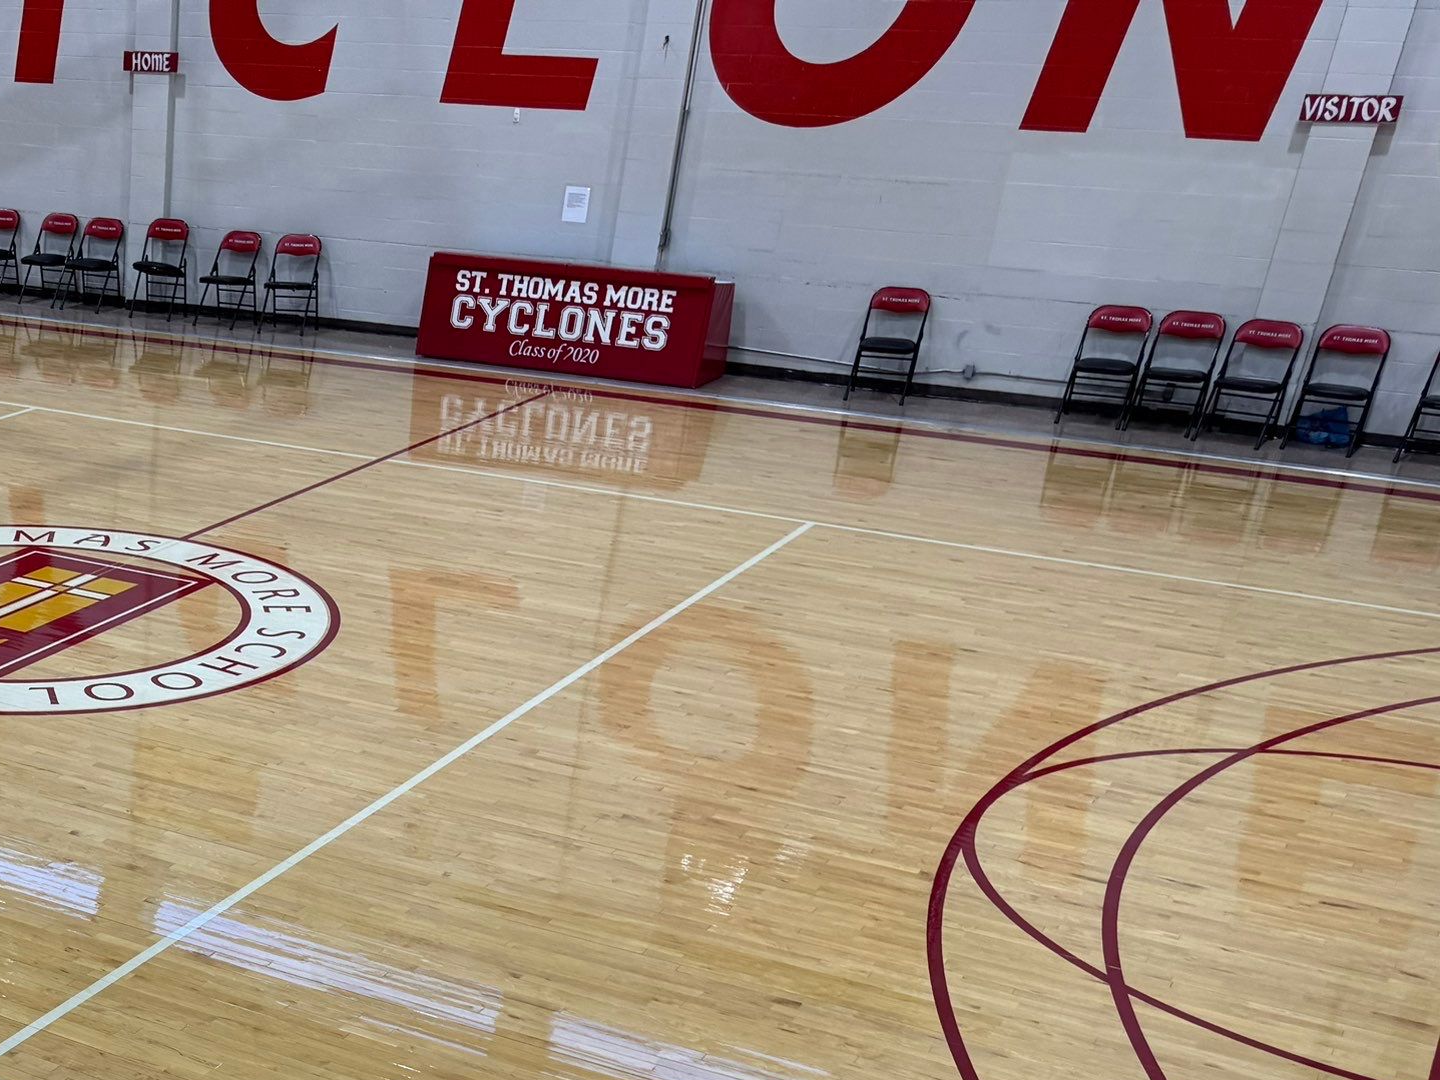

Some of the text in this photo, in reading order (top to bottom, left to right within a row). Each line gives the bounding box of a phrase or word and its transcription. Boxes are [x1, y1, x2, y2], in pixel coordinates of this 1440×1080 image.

[131, 52, 171, 71] HOME
[1304, 96, 1397, 122] VISITOR
[456, 270, 677, 313] ST. THOMAS MORE
[450, 294, 671, 351] CYCLONES
[509, 339, 599, 364] Class of 2020
[186, 553, 312, 613] MORE
[29, 627, 306, 705] SCHOOL
